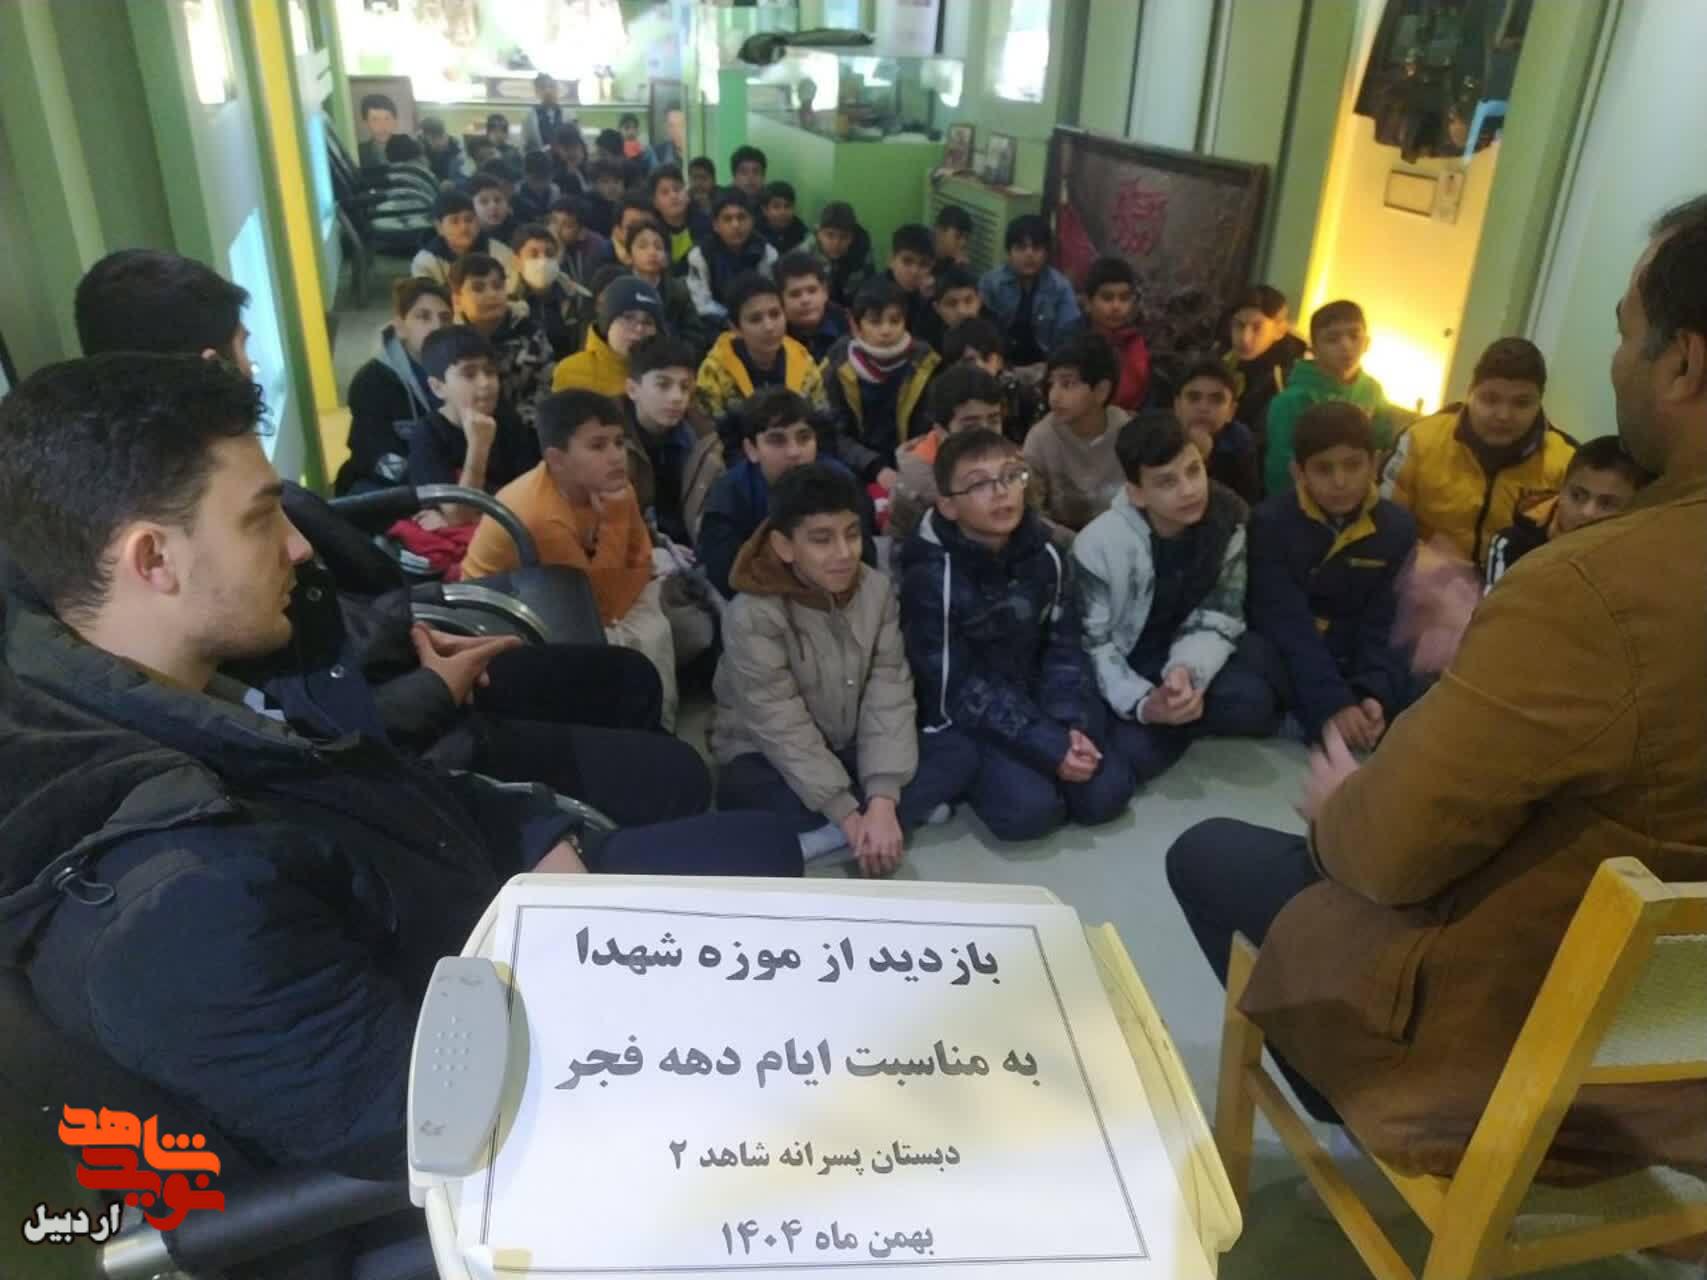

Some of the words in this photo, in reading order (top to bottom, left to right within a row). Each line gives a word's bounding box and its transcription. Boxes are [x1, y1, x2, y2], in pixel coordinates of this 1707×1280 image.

[576, 926, 683, 975] شهدا
[698, 941, 802, 981] موزه
[818, 936, 854, 983] از
[869, 941, 1000, 986] بازدید
[554, 1034, 644, 1090] فجر
[658, 1046, 742, 1076] دهه
[756, 1037, 832, 1088] ایام
[845, 1040, 990, 1087] مناسبت
[1002, 1049, 1041, 1087] به
[669, 1139, 687, 1169] ۲
[699, 1141, 770, 1167] شاهد
[779, 1141, 864, 1176] پسرانه
[872, 1140, 961, 1174] دبستان
[721, 1219, 802, 1255] ۱۴۰۴
[815, 1221, 858, 1250] ماه
[868, 1226, 935, 1257] بهمن
